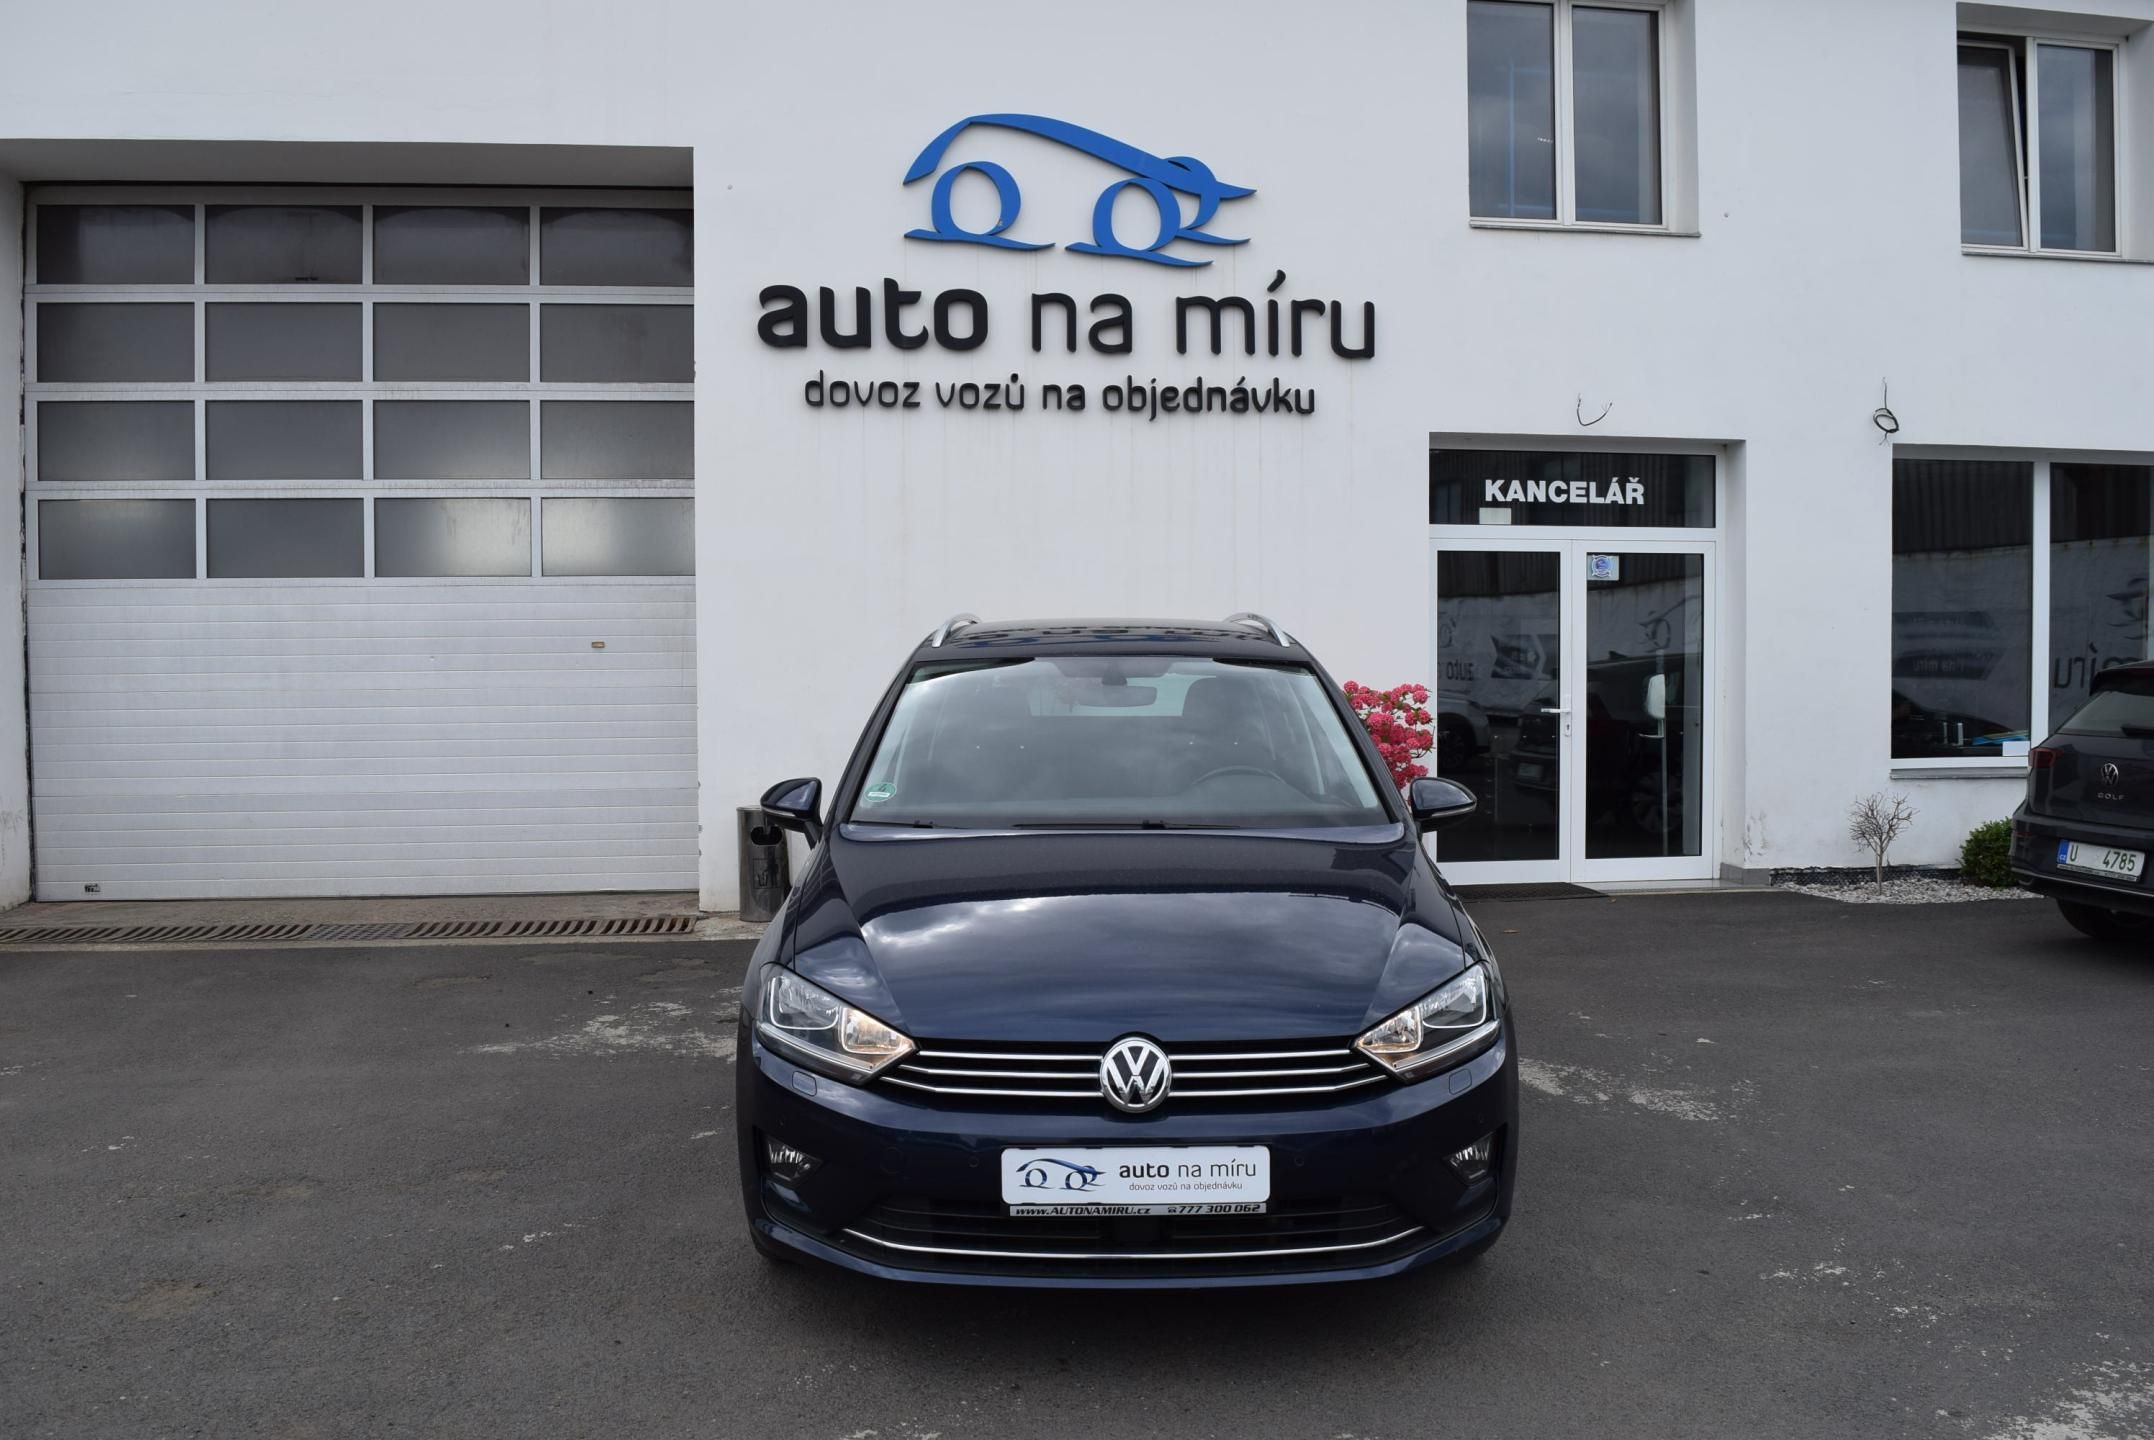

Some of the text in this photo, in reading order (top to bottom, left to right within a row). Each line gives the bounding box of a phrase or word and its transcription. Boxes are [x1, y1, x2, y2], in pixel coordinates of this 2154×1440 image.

[757, 269, 1376, 362] auto na míru
[804, 369, 1317, 422] dovoz vozů na objednávku
[1485, 476, 1645, 505] KANCELÁŘ
[2098, 793, 2125, 801] GOLF
[2103, 849, 2137, 872] 4785
[1119, 1158, 1257, 1179] auto na míru
[1129, 1181, 1243, 1192] dovoz vozů na objednávku
[1015, 1203, 1261, 1216] www.AUTONAMIRU.cz 777 300 062
